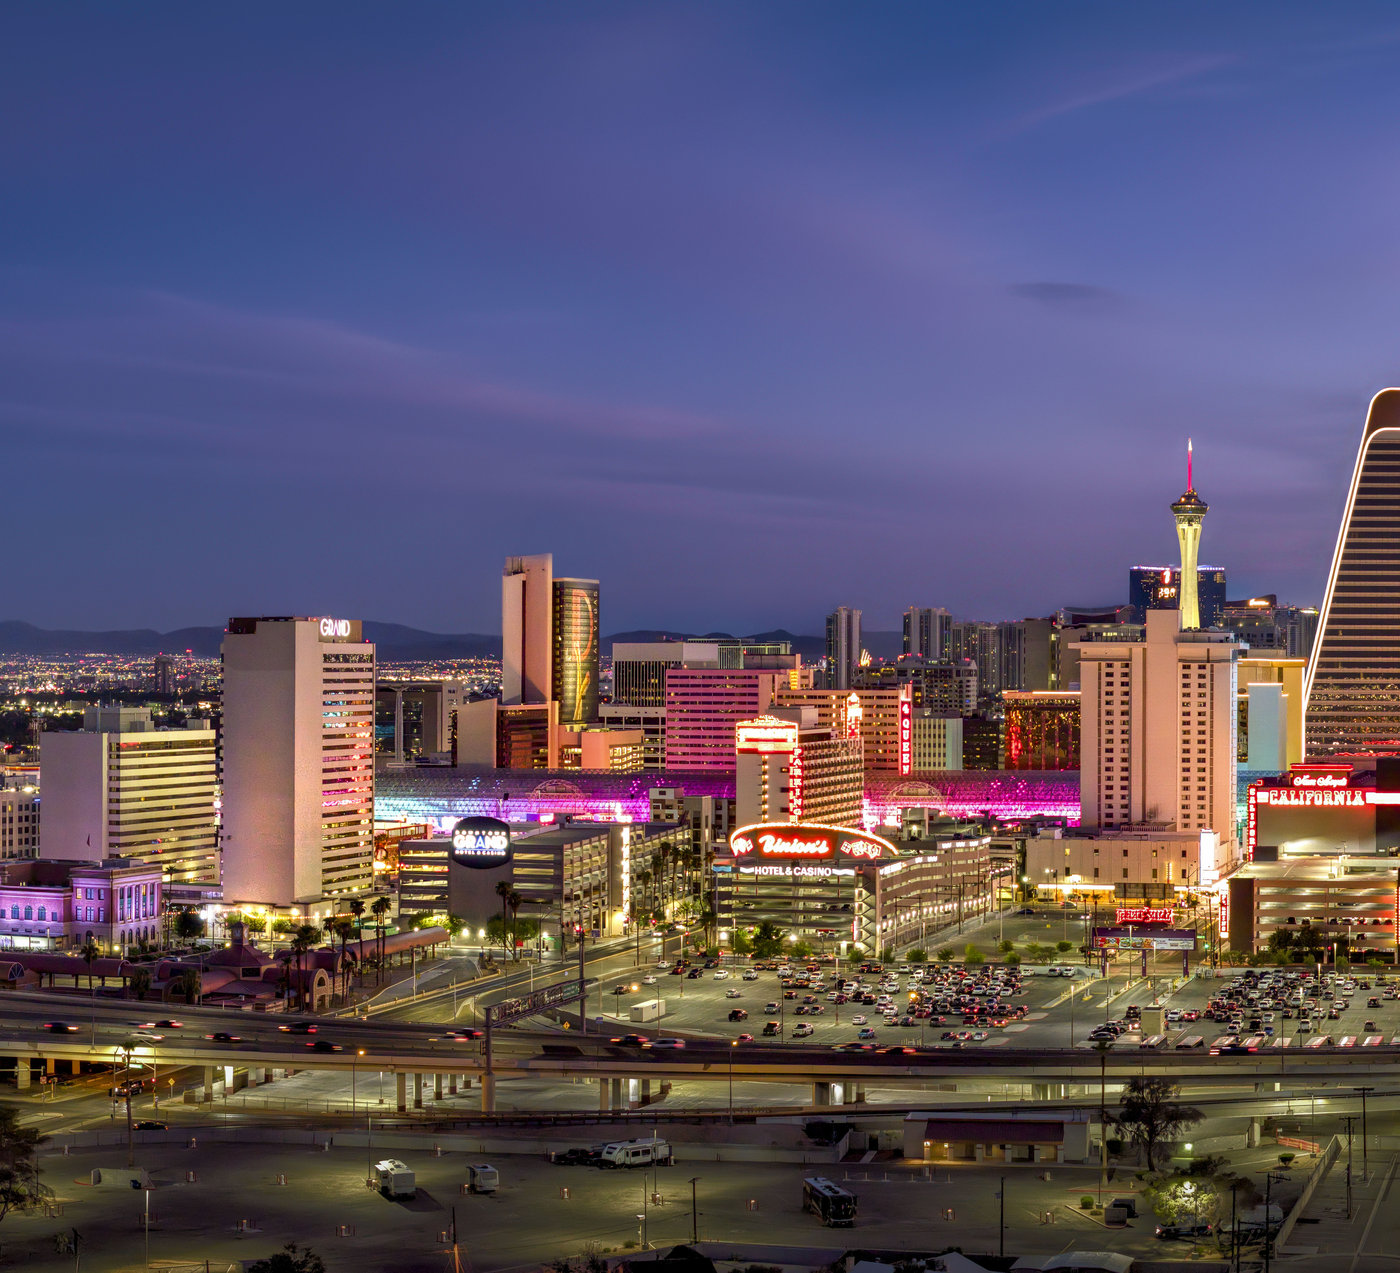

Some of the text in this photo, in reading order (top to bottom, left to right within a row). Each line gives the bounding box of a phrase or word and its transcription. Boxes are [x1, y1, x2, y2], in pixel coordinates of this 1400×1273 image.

[320, 618, 351, 637] GRAND
[902, 704, 910, 714] 4
[793, 748, 803, 816] PARKING
[1269, 790, 1365, 806] CALIFORNIA
[453, 834, 508, 850] GRAND
[759, 835, 830, 854] Binion's
[755, 866, 832, 877] HOTEL & CASINO
